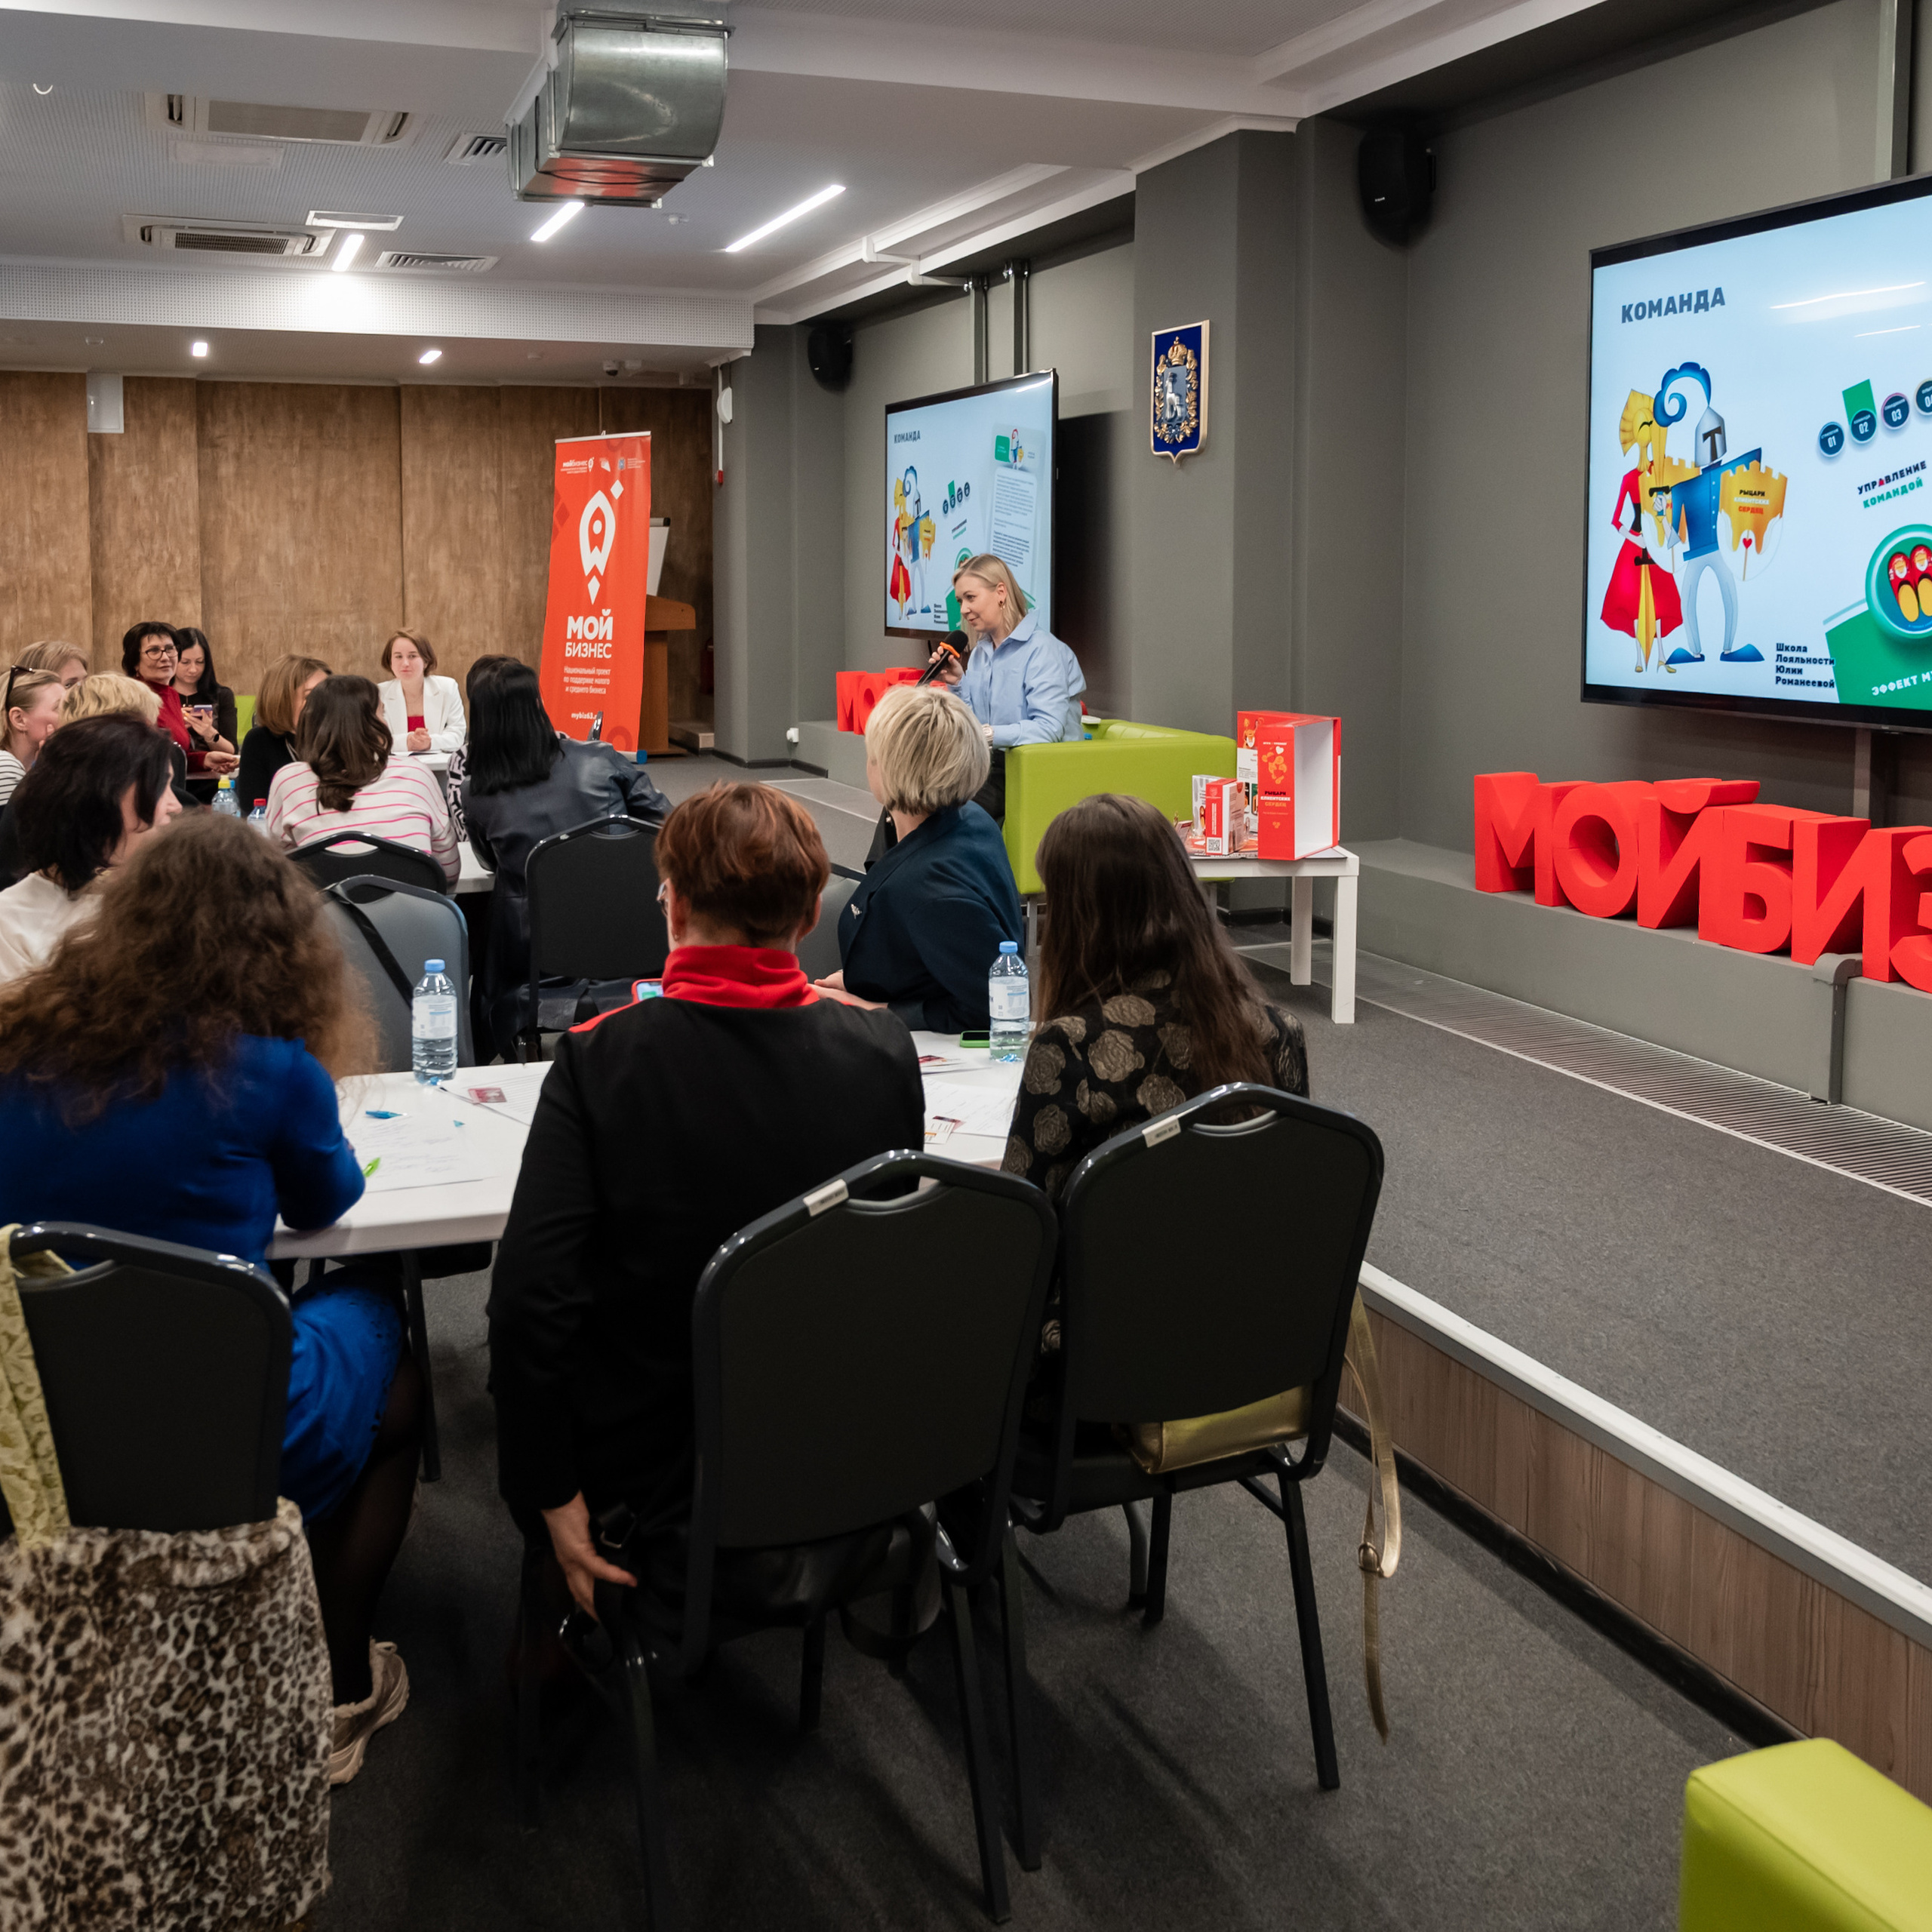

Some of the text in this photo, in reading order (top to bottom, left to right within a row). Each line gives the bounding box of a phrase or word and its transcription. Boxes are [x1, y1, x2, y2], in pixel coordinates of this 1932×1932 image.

[1621, 287, 1726, 324] КОМАНДА
[1891, 408, 1902, 422] 03
[1859, 421, 1869, 434] 02
[894, 430, 921, 444] КОМАНДА
[1828, 435, 1837, 448] 01
[1857, 460, 1927, 494] УПРАВЛЕНИЕ
[1739, 489, 1766, 497] РЫЦАРИ
[1863, 477, 1924, 509] КОМАНДОЙ
[1738, 506, 1764, 515] СЕРДЕЦ
[567, 608, 614, 640] МОЙ
[565, 641, 612, 659] БИЗНЕС
[1775, 642, 1807, 653] Школа
[1775, 654, 1835, 666] Лояльности
[1775, 665, 1803, 675] Юлии
[1775, 675, 1835, 688] Романеевой
[1872, 675, 1918, 696] ЭФФЕКТ
